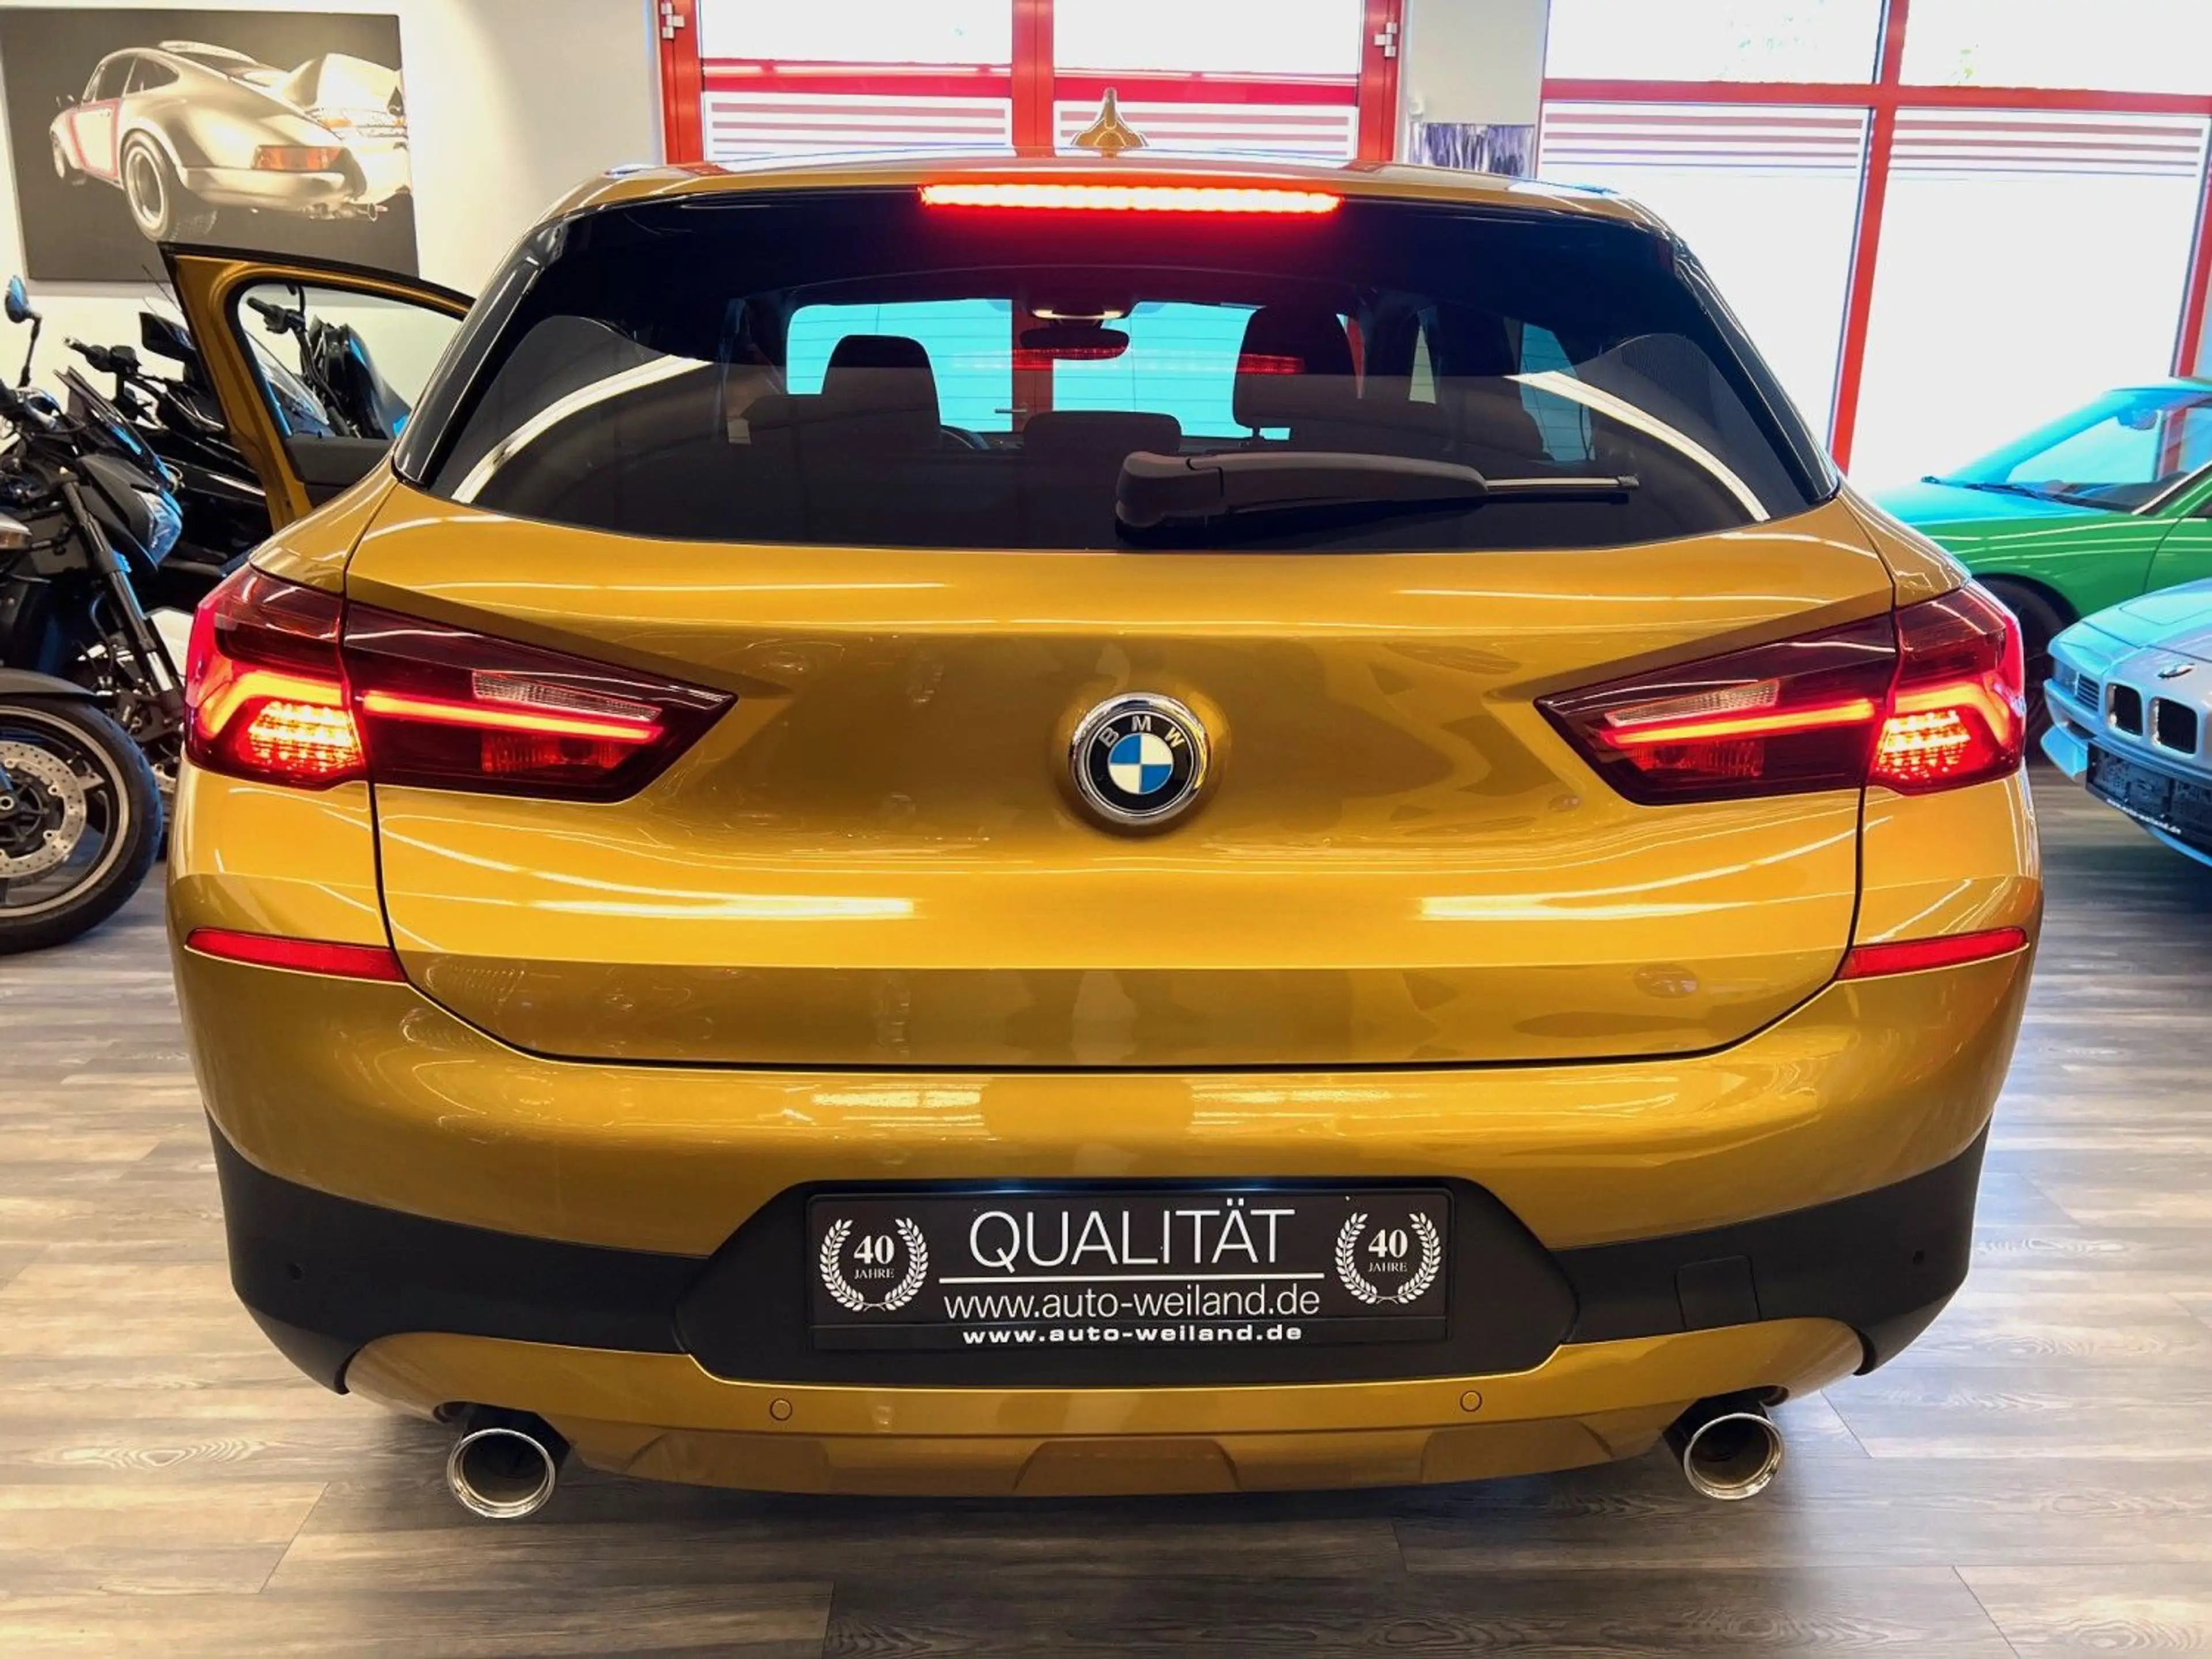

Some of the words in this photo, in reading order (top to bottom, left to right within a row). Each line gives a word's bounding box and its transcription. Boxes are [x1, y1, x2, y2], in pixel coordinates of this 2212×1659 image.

[1099, 715, 1185, 748] BMW
[853, 1234, 895, 1264] 40
[969, 1197, 1296, 1274] QUALITÄT
[1368, 1229, 1409, 1259] 40
[854, 1268, 895, 1279] JAHRE
[1368, 1262, 1407, 1272] JAHRE
[943, 1282, 1321, 1320] www.auto-weiland.de
[962, 1323, 1302, 1344] www.auto-weiland.de
